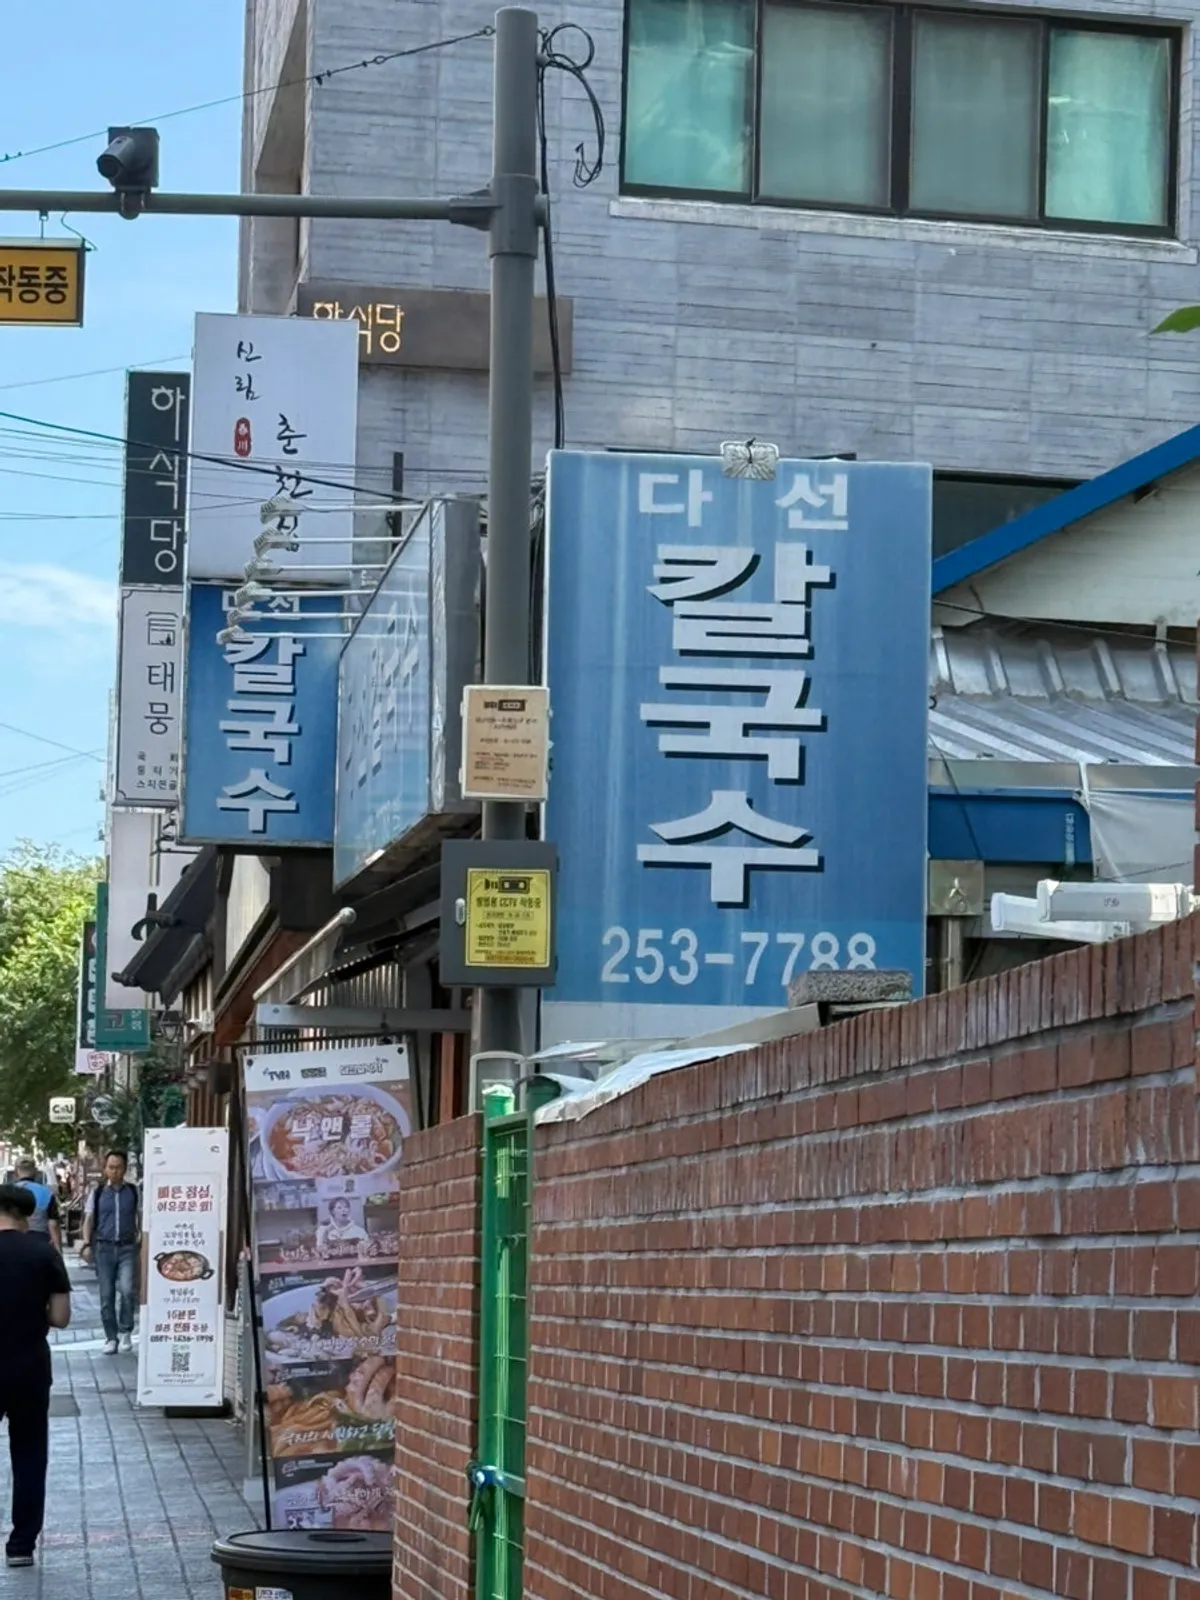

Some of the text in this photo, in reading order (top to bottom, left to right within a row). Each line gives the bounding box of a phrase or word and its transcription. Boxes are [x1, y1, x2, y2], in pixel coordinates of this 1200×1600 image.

[235, 341, 262, 401] 신림
[216, 636, 306, 833] 칼국수
[637, 542, 836, 909] 칼국수
[601, 925, 877, 985] 253-7788
